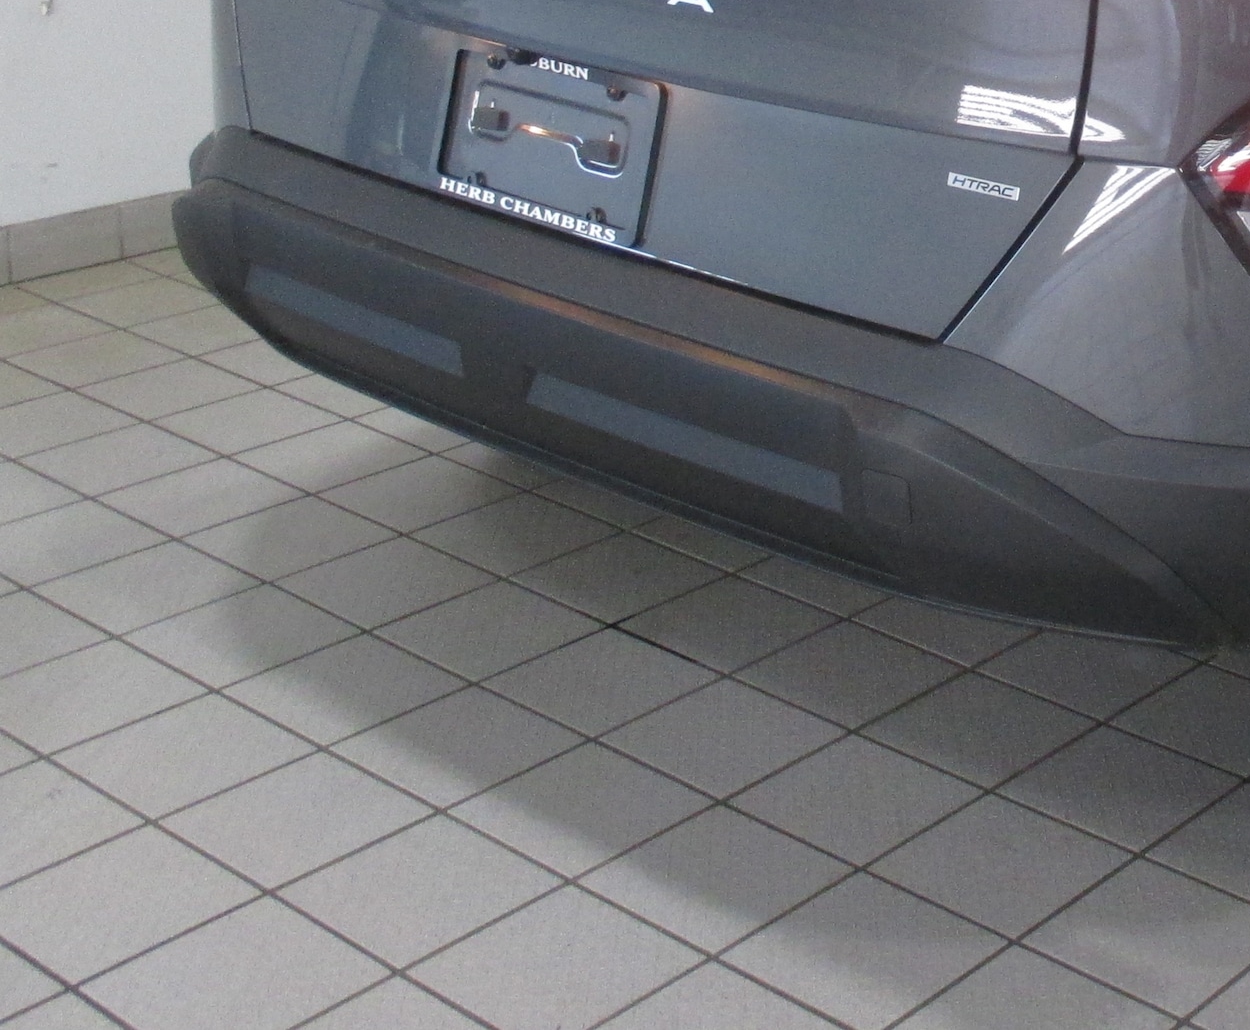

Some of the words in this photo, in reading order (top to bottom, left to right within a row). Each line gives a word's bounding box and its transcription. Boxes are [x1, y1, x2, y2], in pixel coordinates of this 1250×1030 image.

[530, 57, 588, 80] BURN
[952, 175, 1014, 198] HTRAC
[439, 177, 495, 204] HERB
[500, 196, 616, 242] CHAMBERS
